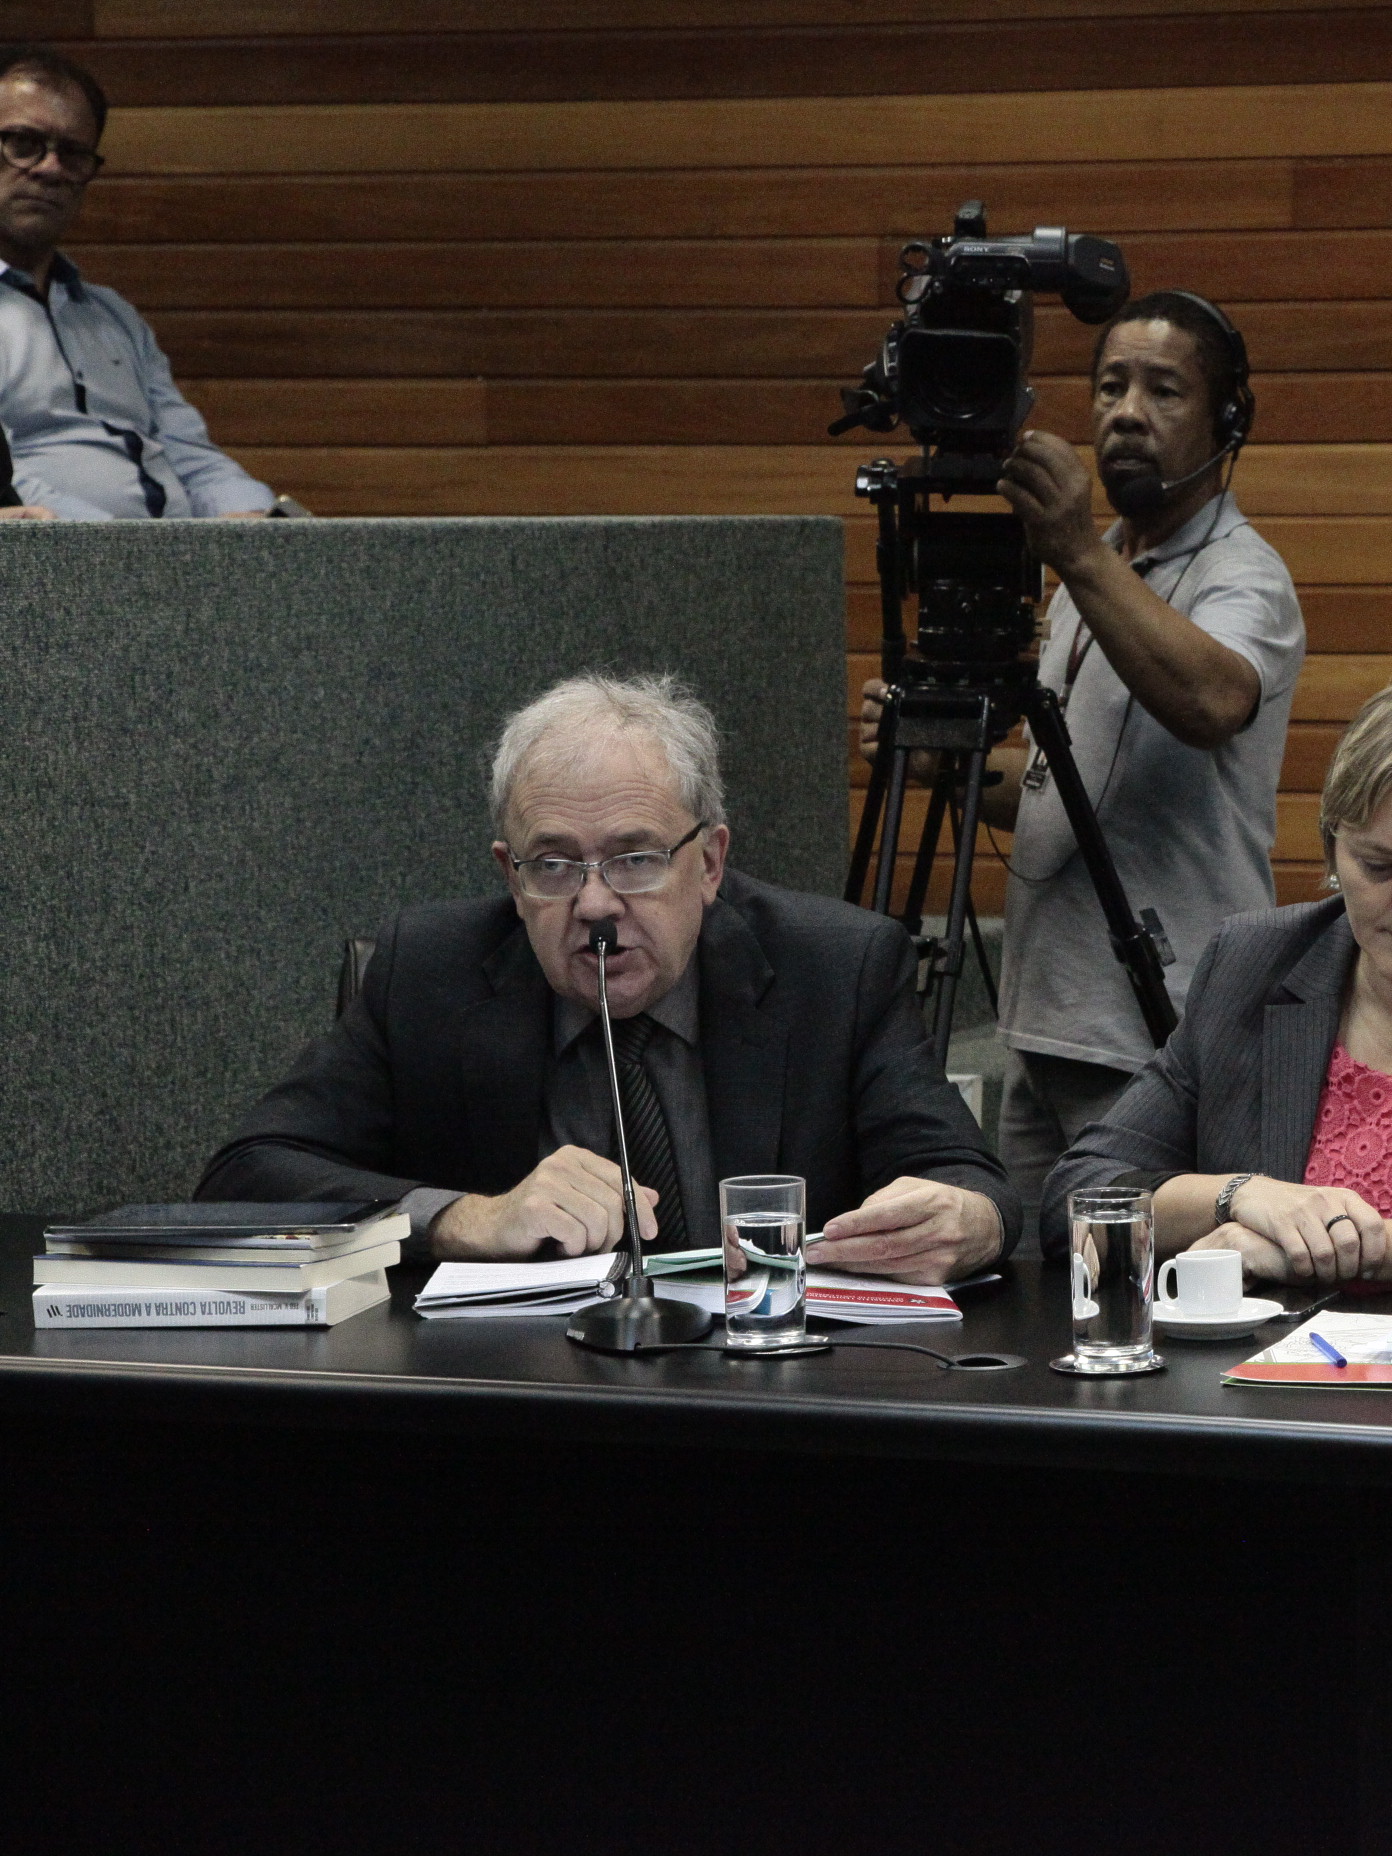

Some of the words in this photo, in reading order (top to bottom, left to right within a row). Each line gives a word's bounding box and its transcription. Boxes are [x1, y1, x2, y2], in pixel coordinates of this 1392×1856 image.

[66, 1303, 142, 1318] MODERNIDADE
[145, 1302, 151, 1317] A
[154, 1301, 196, 1316] CONTRA
[200, 1300, 246, 1315] REVOLTA
